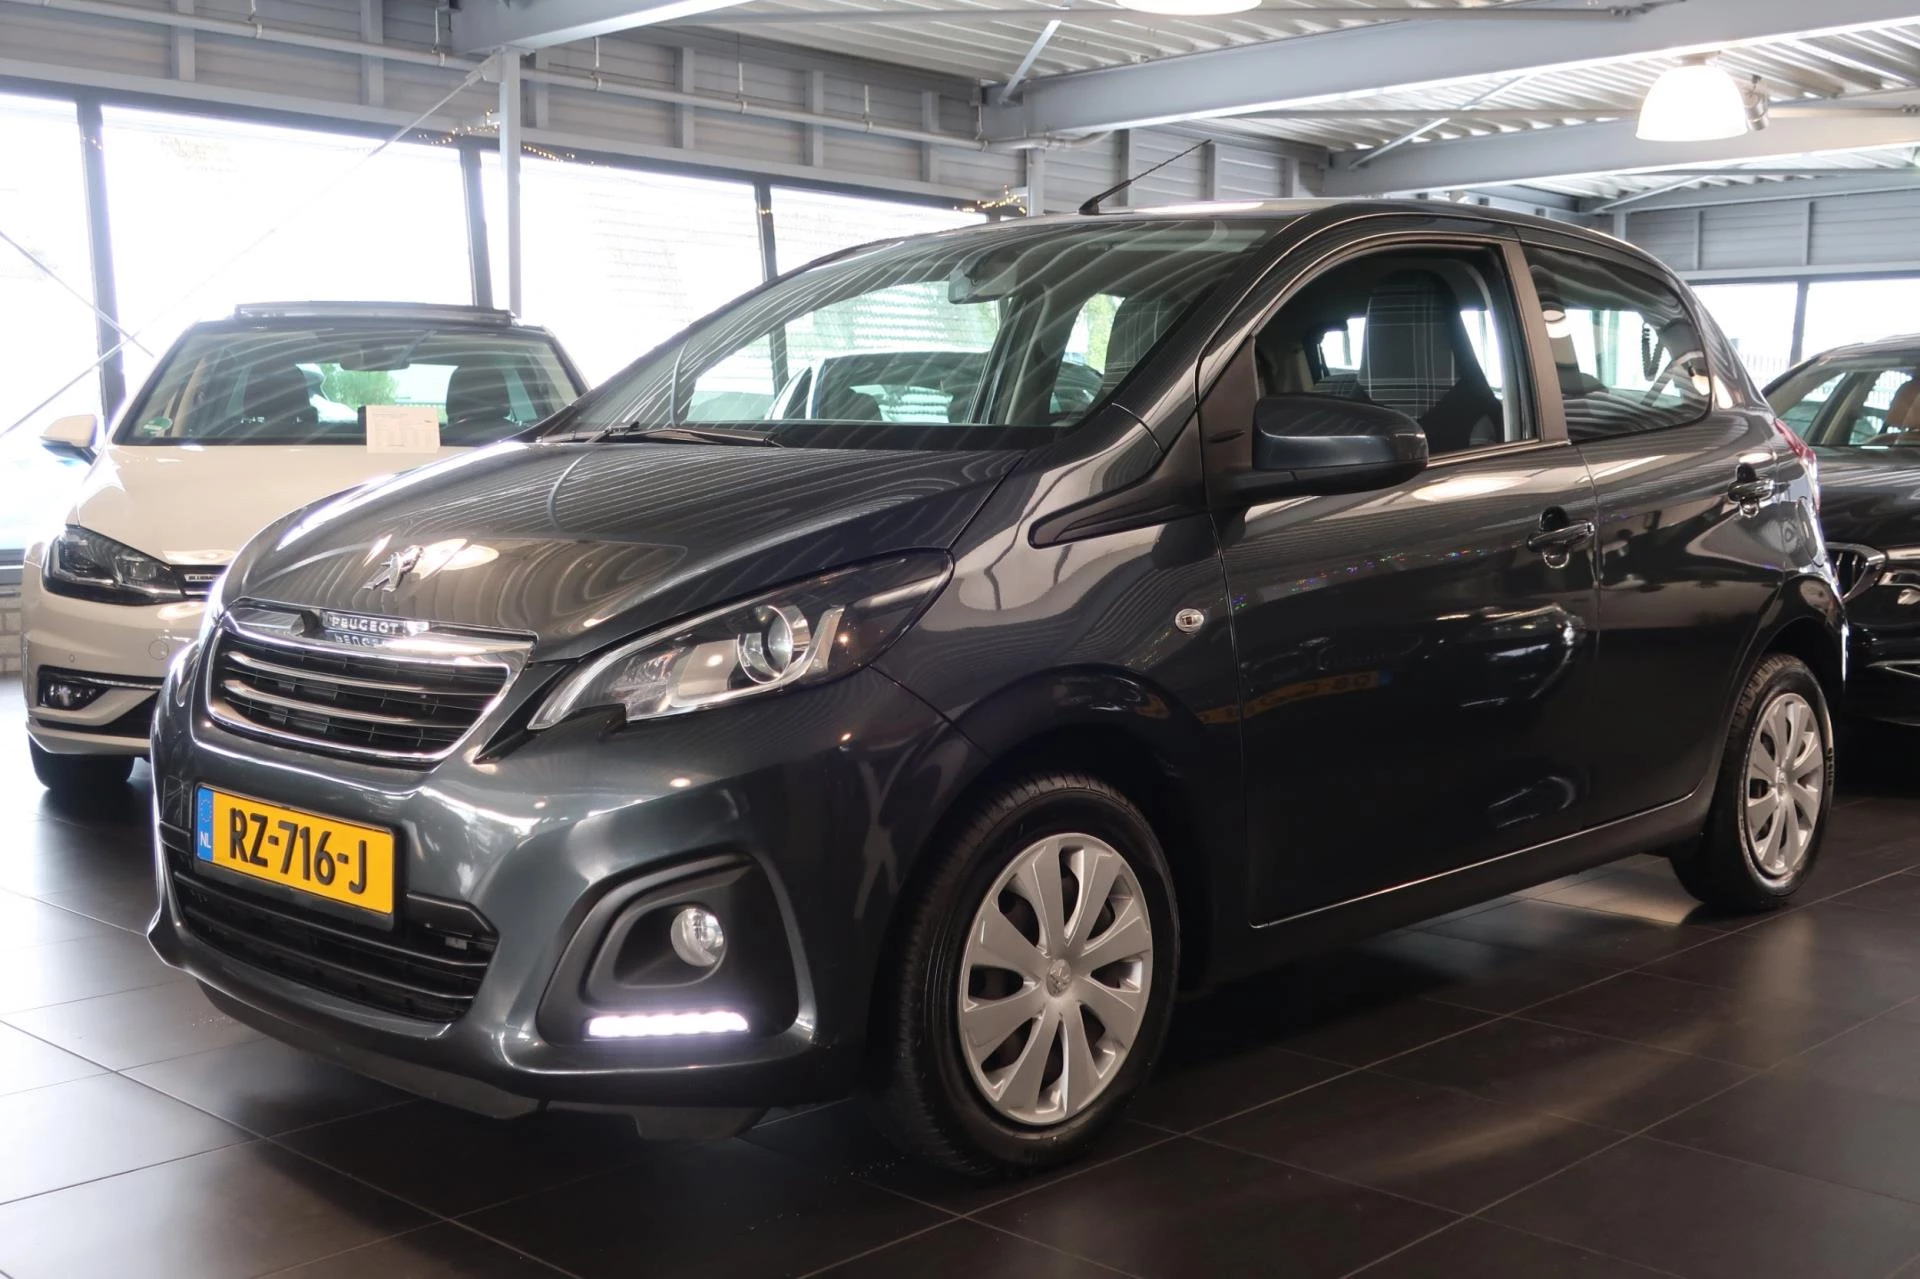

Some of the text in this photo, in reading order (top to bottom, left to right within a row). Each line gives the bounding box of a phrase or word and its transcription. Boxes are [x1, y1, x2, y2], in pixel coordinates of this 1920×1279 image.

[331, 615, 399, 635] PEUGEOT
[200, 831, 211, 849] NL
[229, 807, 367, 894] RZ-716-J
